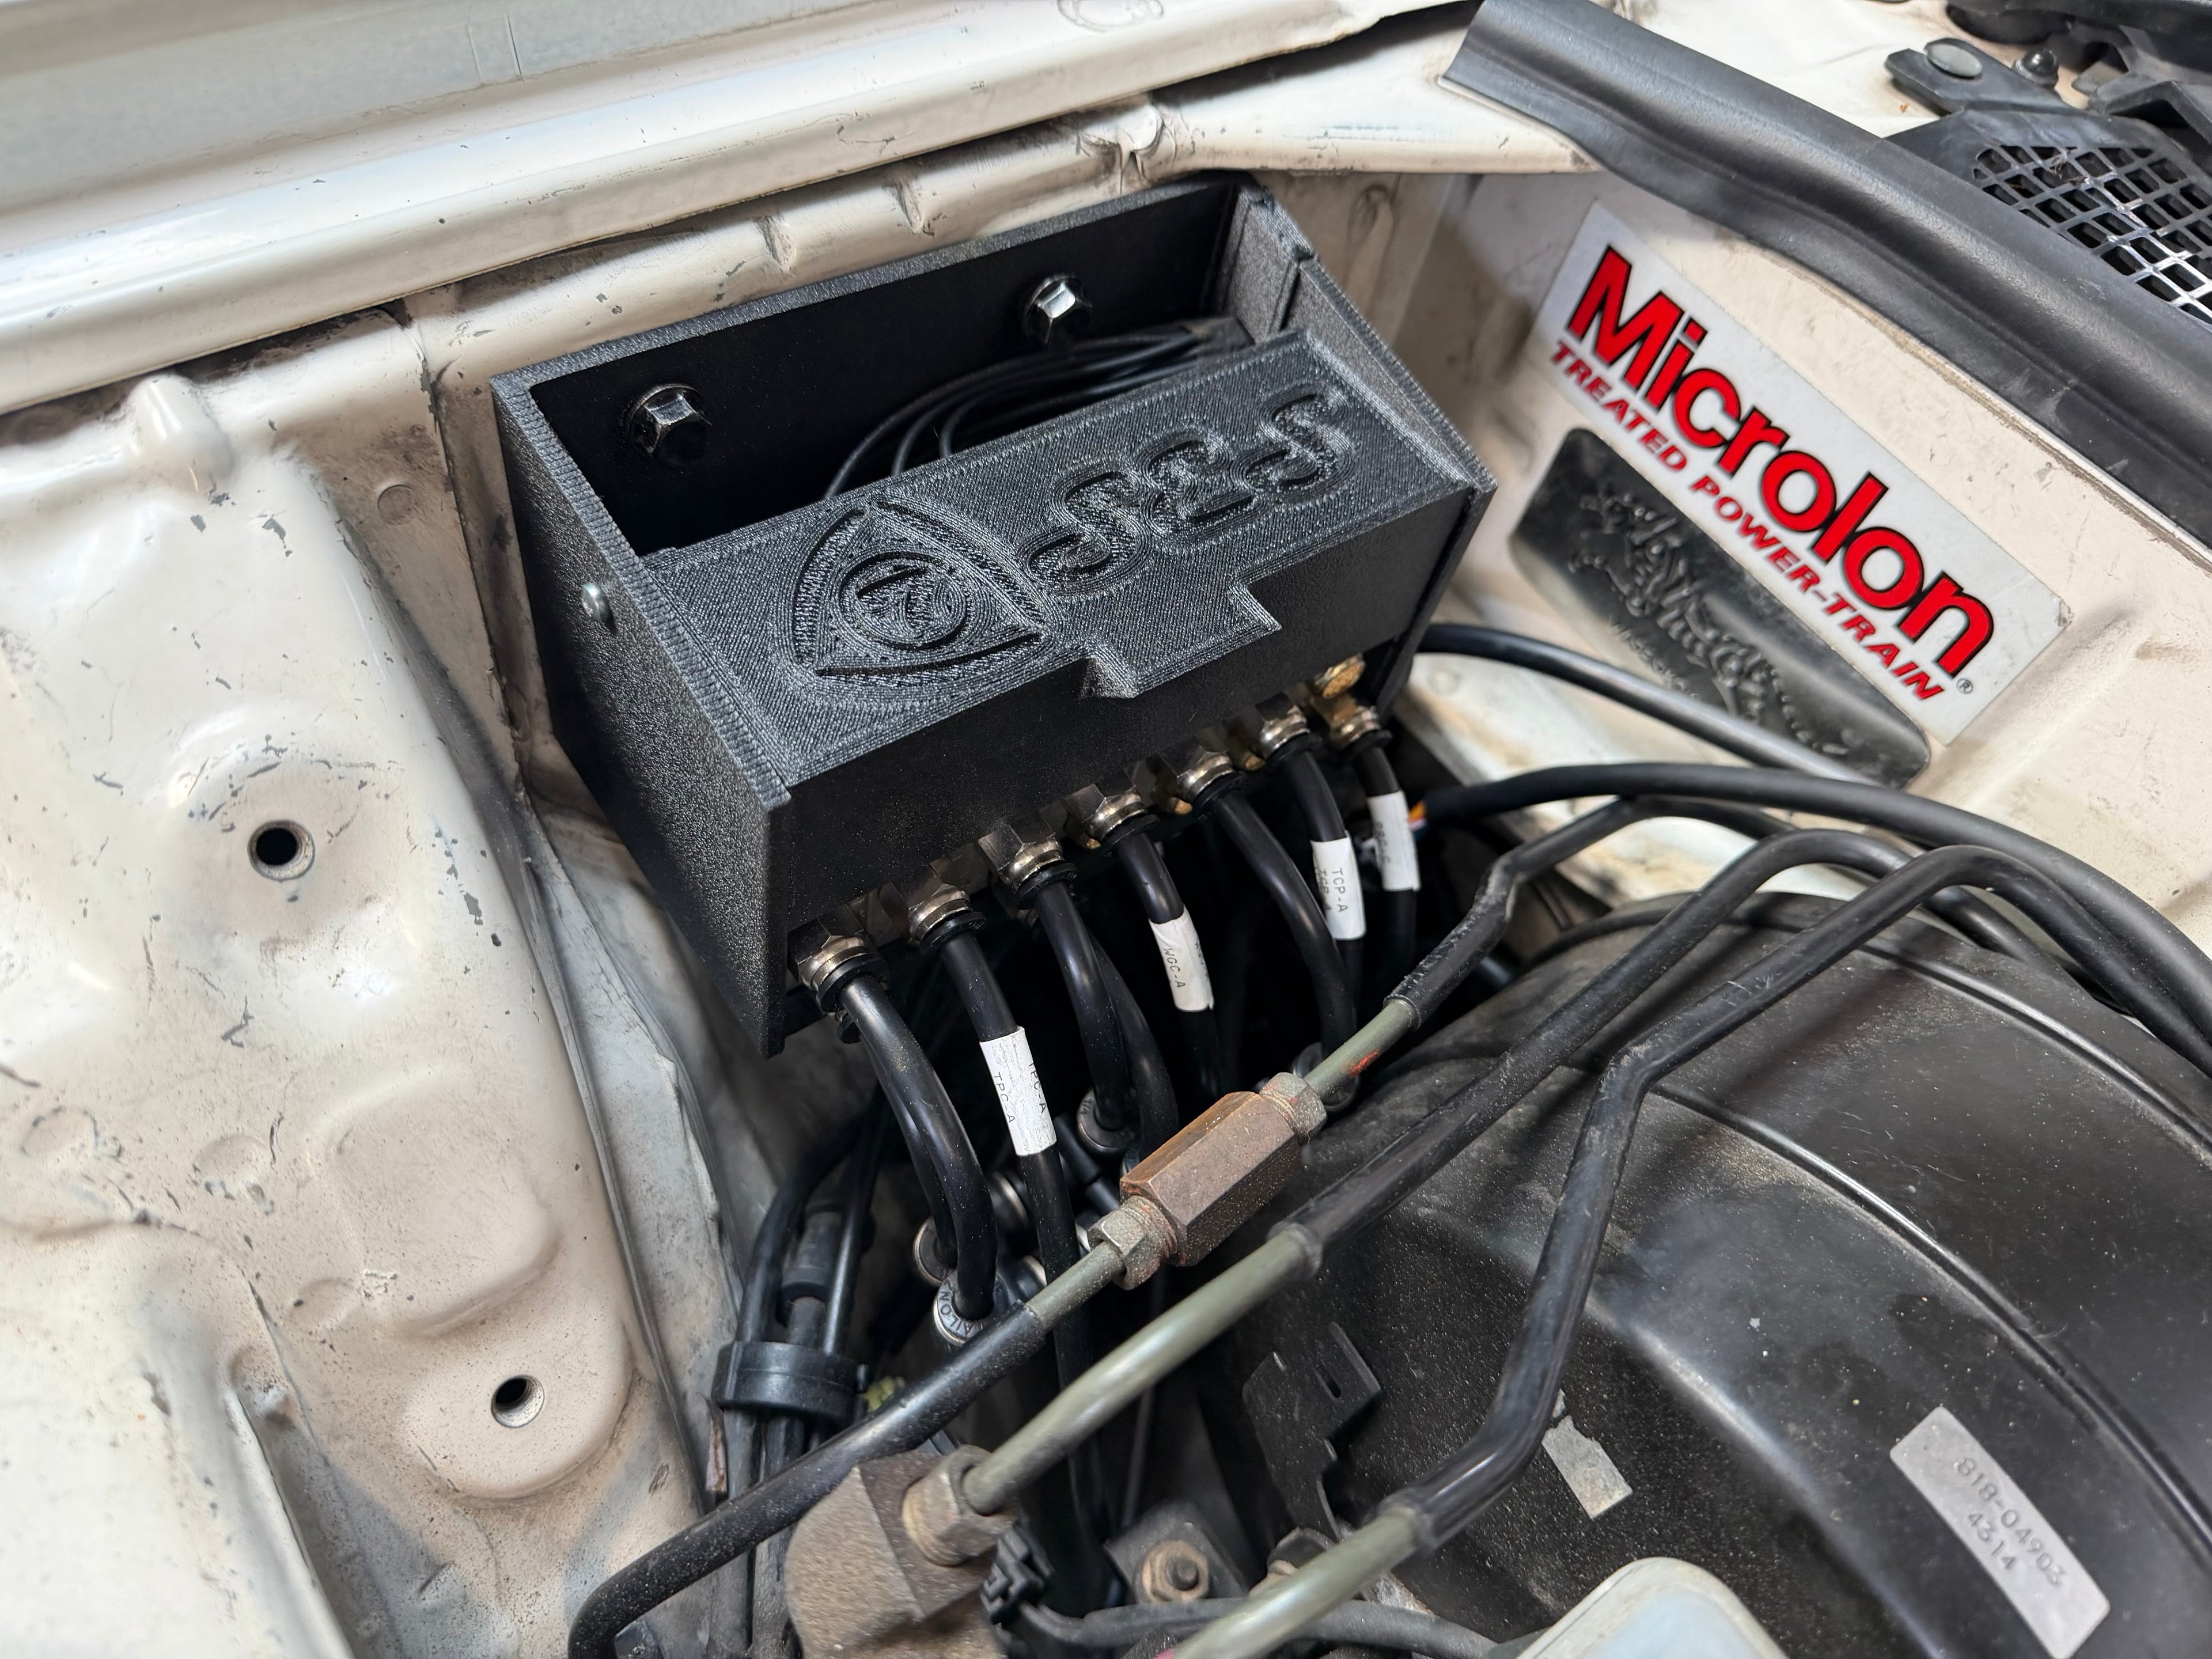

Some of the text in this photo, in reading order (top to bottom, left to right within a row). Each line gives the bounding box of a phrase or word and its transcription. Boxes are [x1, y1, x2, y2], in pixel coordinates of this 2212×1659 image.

[1566, 245, 1995, 680] Microlon
[1550, 340, 1945, 701] TREATED POWER-TRAIN
[1331, 867, 1349, 912] TCP-A
[1162, 948, 1186, 988] WGC-A
[993, 1071, 1016, 1123] TPC-A
[1957, 1456, 2066, 1588] 818-04903
[1967, 1512, 2017, 1571] 4314
